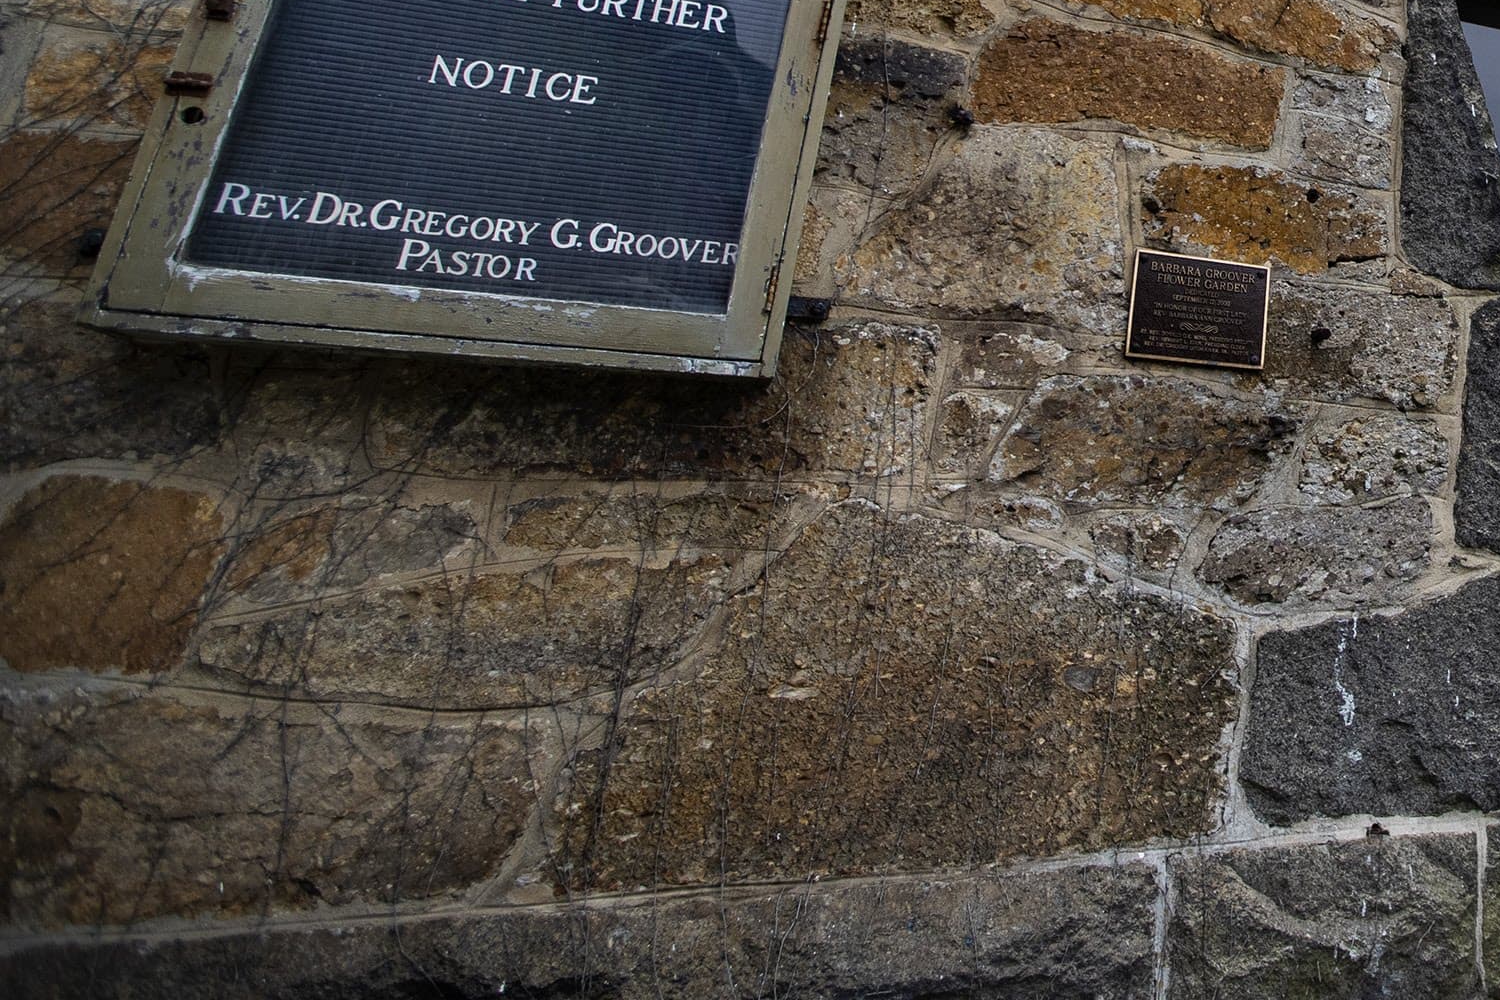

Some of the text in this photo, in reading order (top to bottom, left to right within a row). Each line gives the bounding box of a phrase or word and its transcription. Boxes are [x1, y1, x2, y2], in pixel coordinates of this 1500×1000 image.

[428, 54, 599, 105] NOTICE
[396, 238, 537, 281] PASTOR
[1151, 261, 1255, 283] BARBARA GROOVER
[1156, 273, 1248, 294] FLOWER GARDEN
